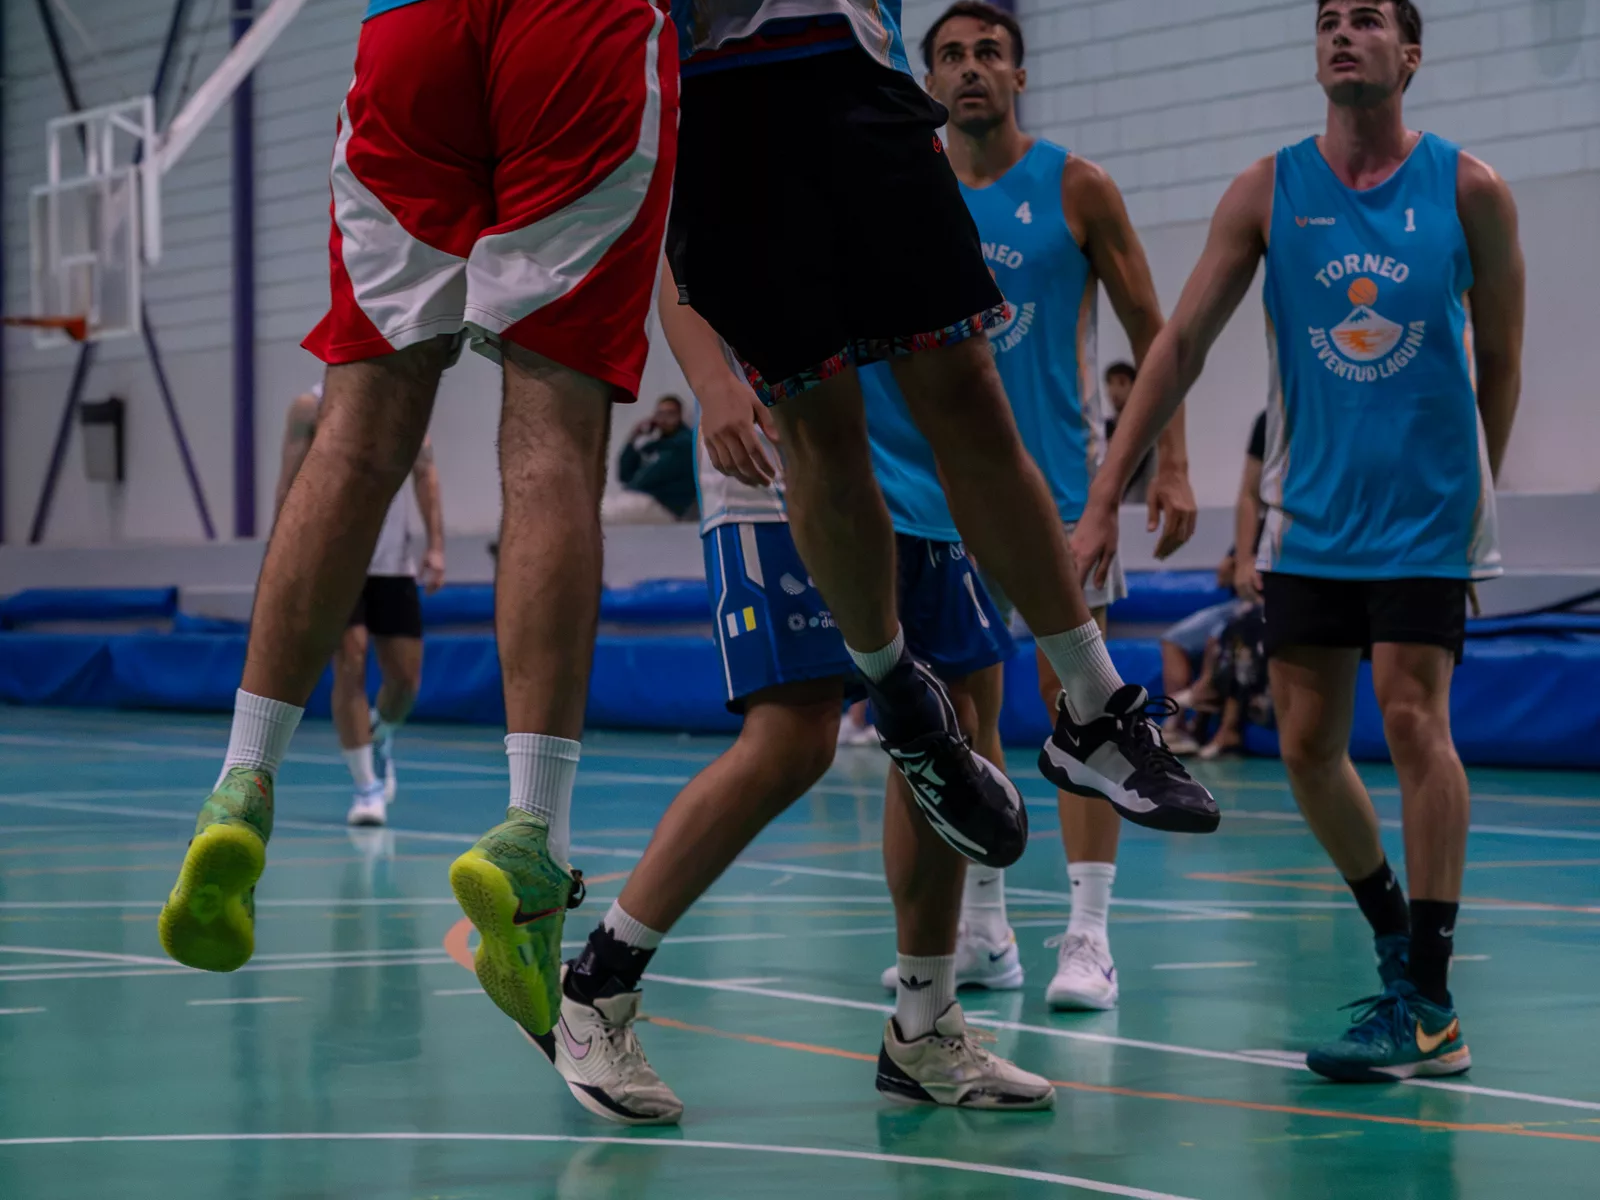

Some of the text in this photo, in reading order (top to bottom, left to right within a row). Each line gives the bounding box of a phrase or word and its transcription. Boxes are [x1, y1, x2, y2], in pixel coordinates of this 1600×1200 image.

[1014, 200, 1033, 224] 4
[1403, 208, 1416, 233] 1
[1314, 253, 1410, 289] TORNEO
[999, 302, 1036, 353] LAGUNA
[1308, 319, 1427, 382] JUVENTUD LAGUNA
